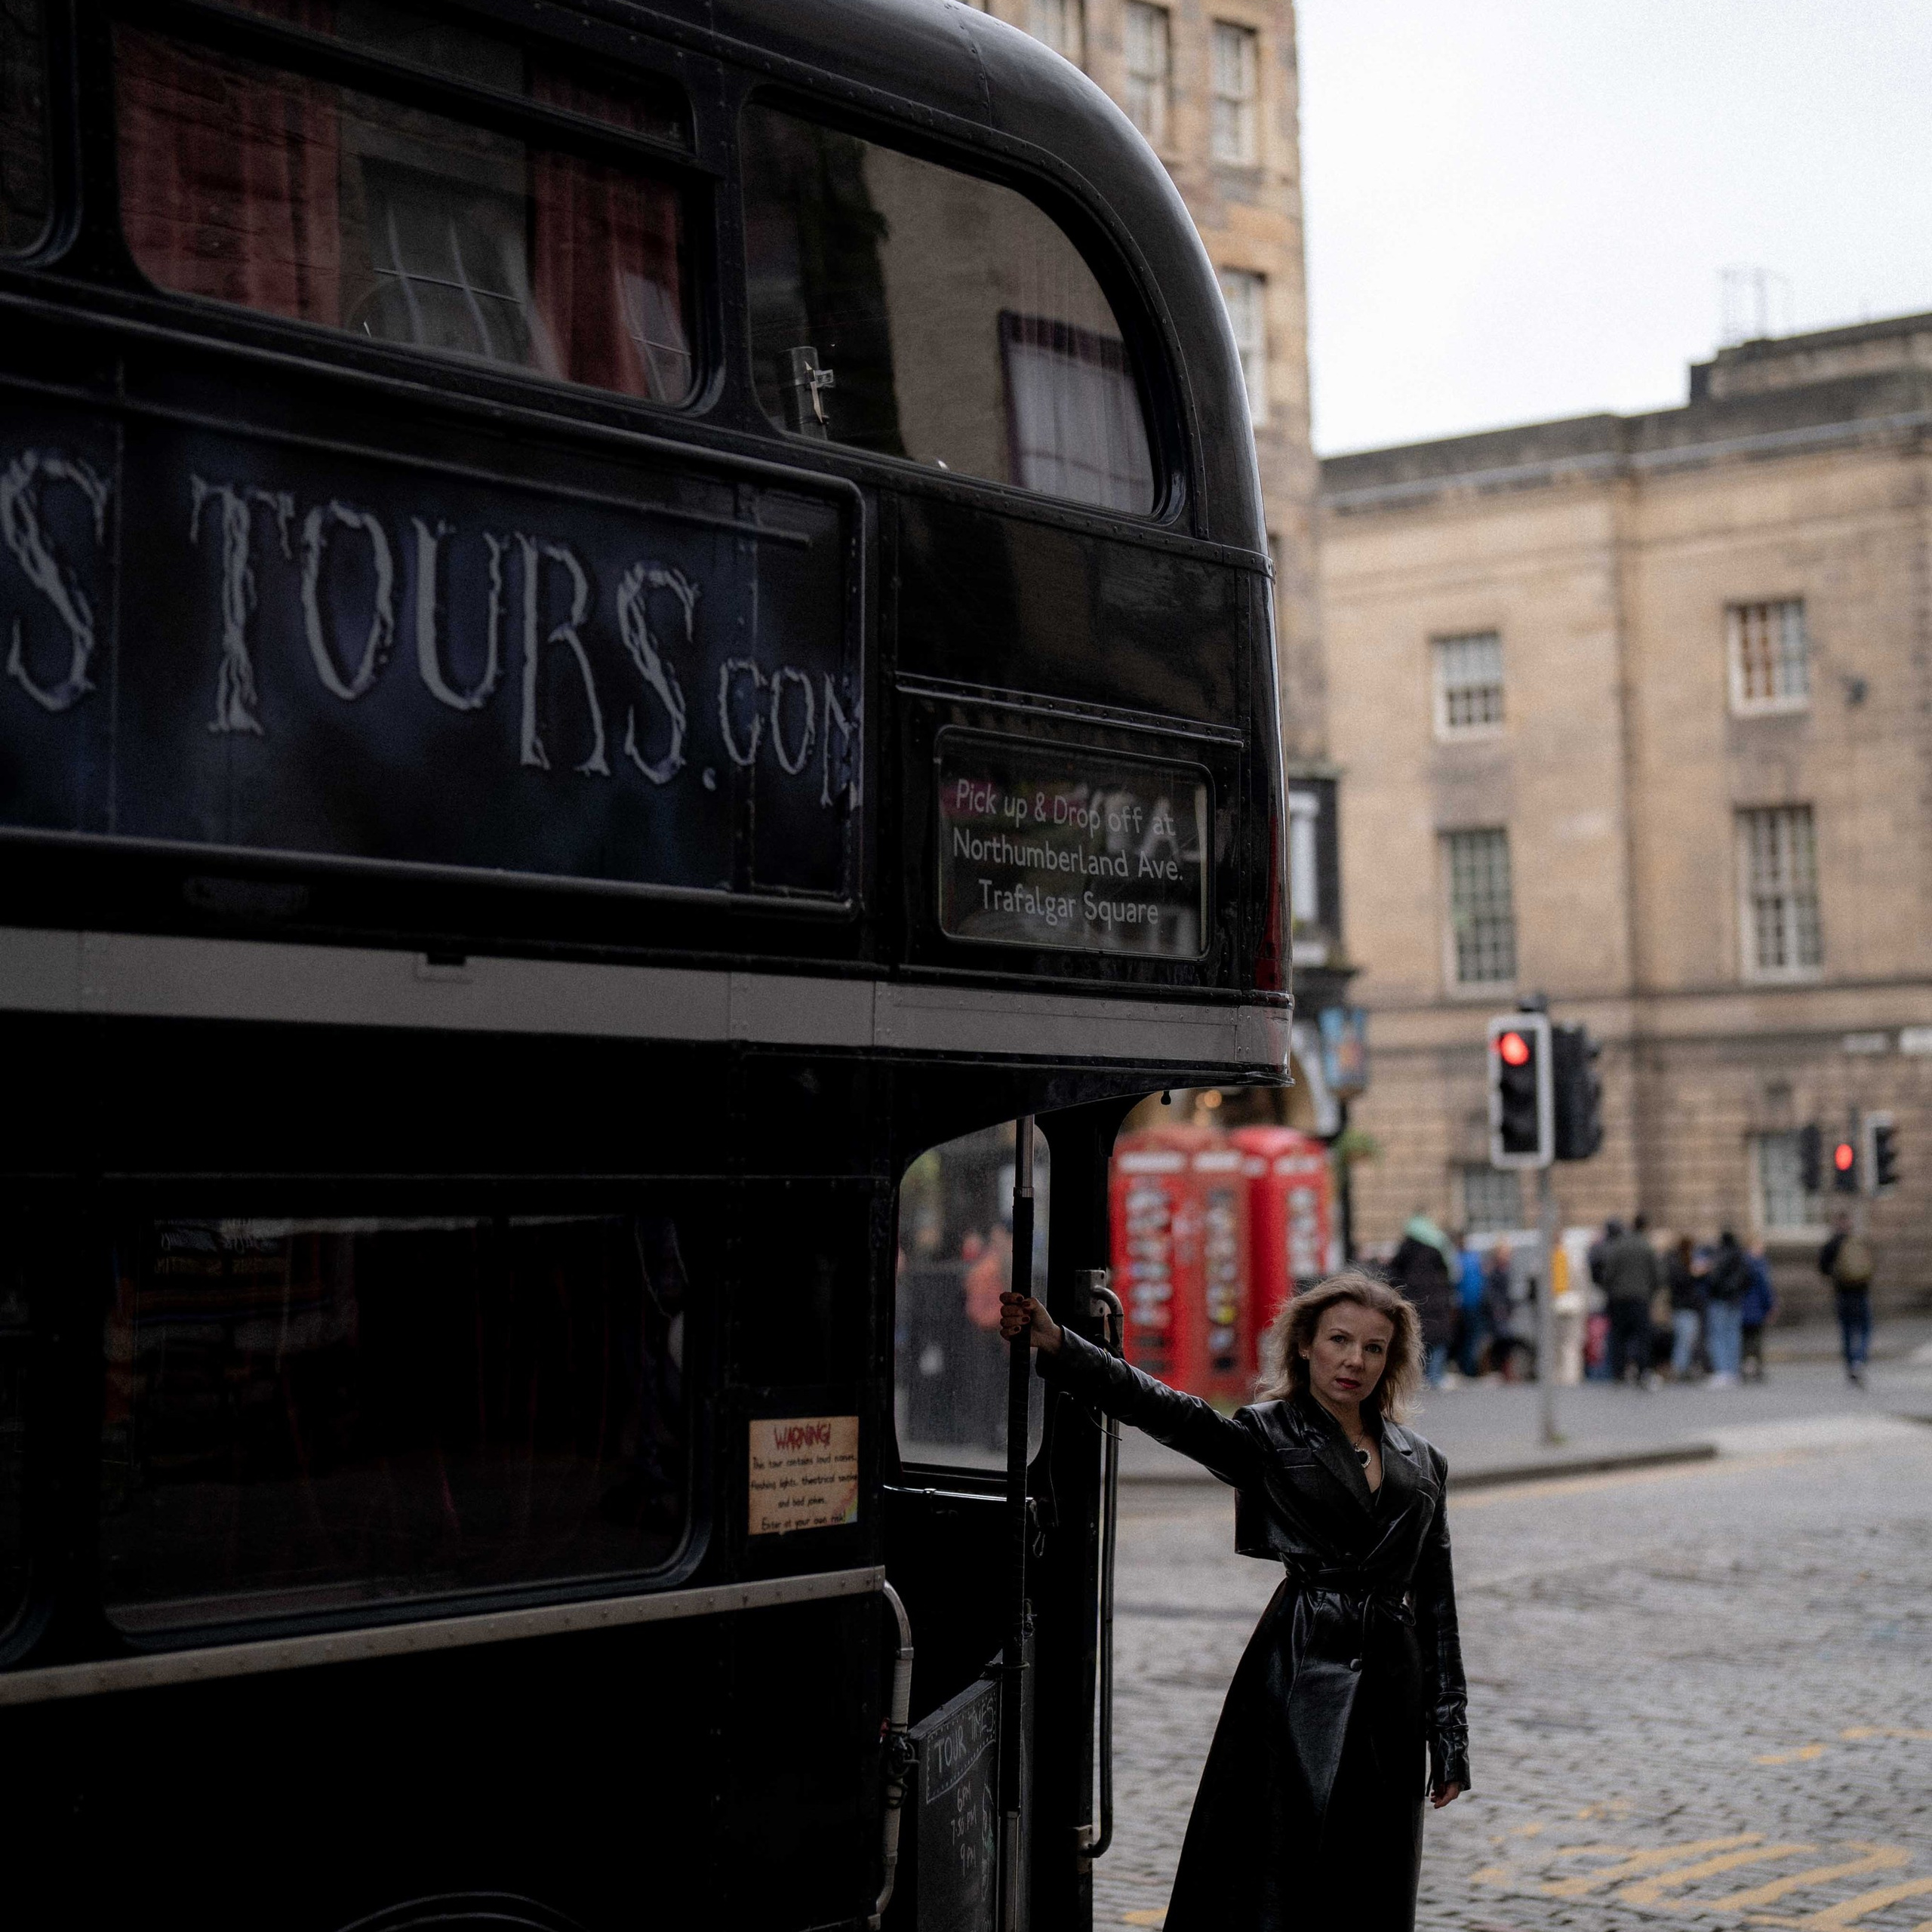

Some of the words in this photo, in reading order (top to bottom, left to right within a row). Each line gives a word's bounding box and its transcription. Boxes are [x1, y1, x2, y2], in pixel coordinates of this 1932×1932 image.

[956, 778, 996, 815] Pick
[1004, 797, 1028, 828] up
[1034, 792, 1047, 823] &
[1054, 795, 1101, 838] Drop
[1107, 806, 1143, 834] off
[1152, 814, 1177, 837] at
[953, 827, 1129, 878] Northumberland
[1137, 851, 1184, 881] Ave.
[978, 878, 1077, 926] Trafalgar
[1083, 891, 1159, 931] Square
[934, 1725, 967, 1774] TOUR
[968, 1697, 994, 1742] TIMES
